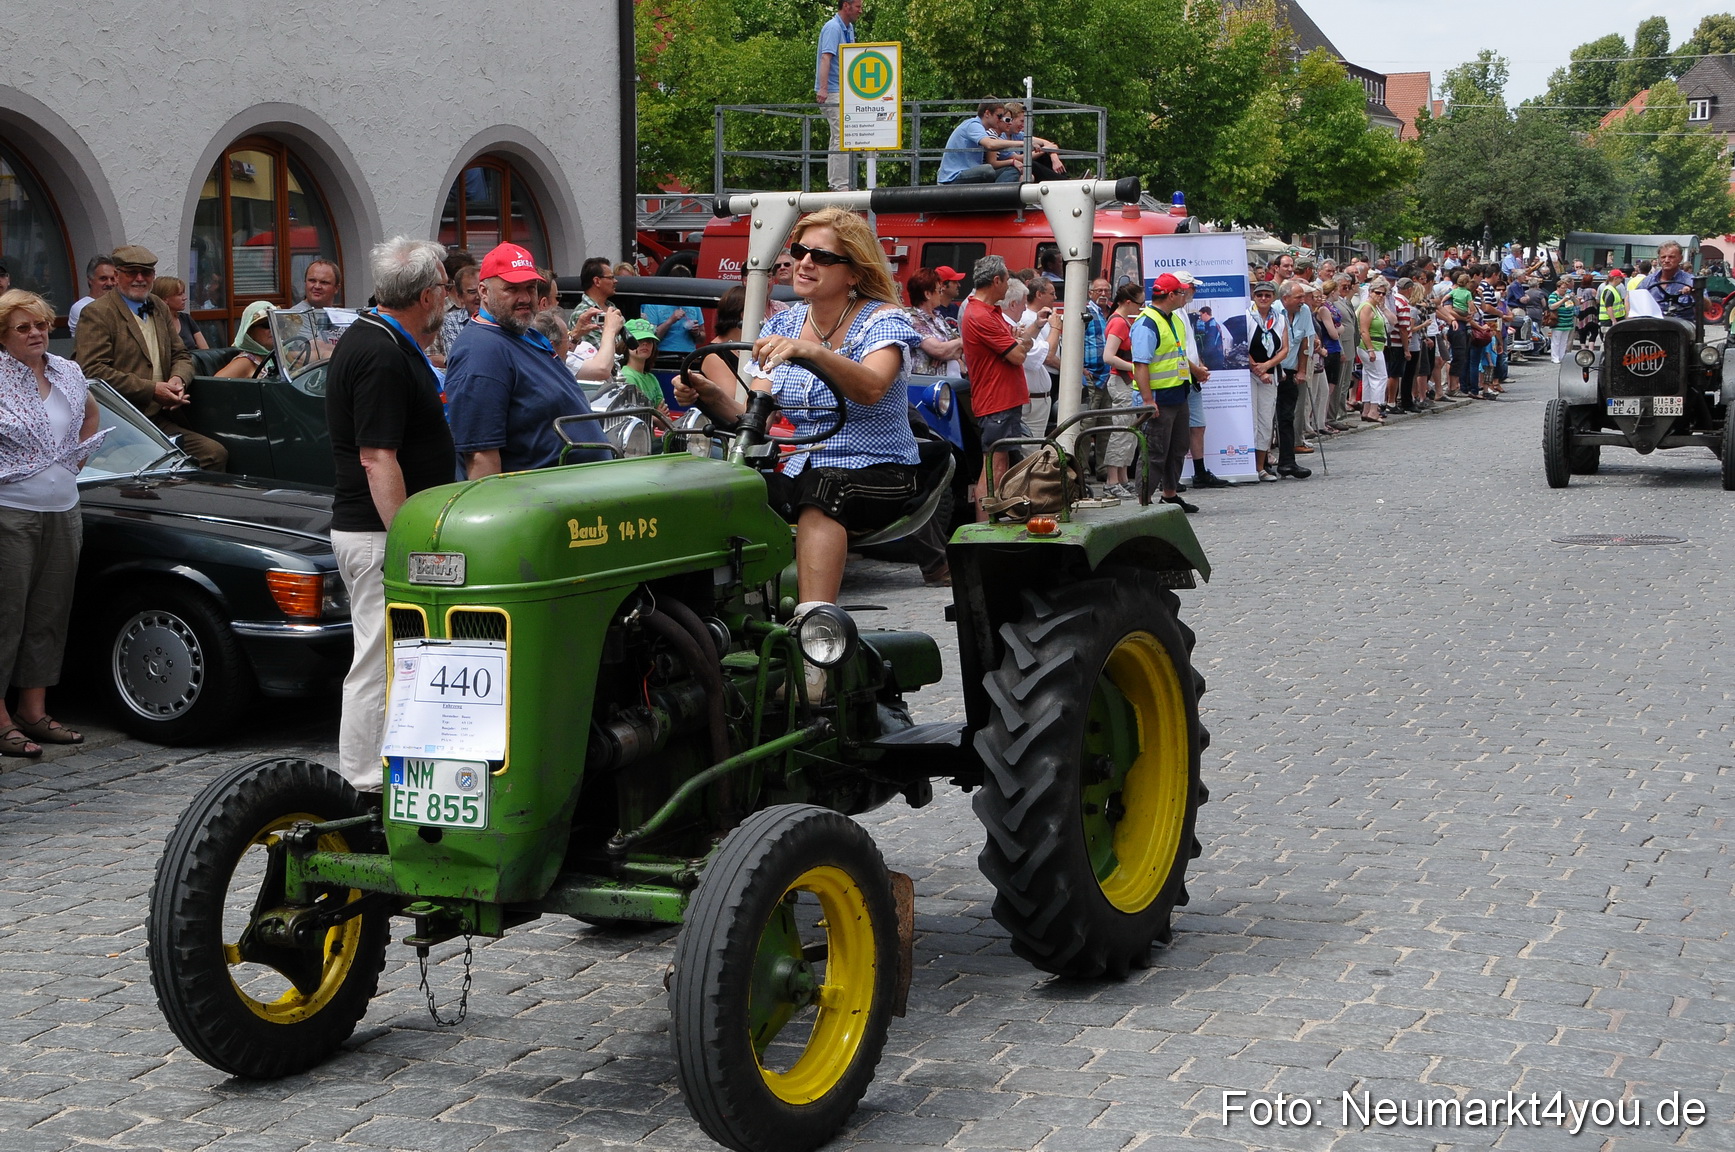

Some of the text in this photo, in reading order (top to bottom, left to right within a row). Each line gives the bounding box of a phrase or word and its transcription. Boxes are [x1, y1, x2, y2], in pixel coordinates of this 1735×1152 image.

[860, 62, 881, 88] H
[718, 257, 741, 271] KOL
[1154, 258, 1187, 268] KOLLER
[1194, 259, 1234, 267] Schwemmer
[1631, 345, 1658, 371] DIESEL
[567, 515, 658, 548] Bautz 14 PS
[430, 665, 492, 699] 440
[407, 760, 434, 790] NM
[394, 789, 479, 824] EE 855
